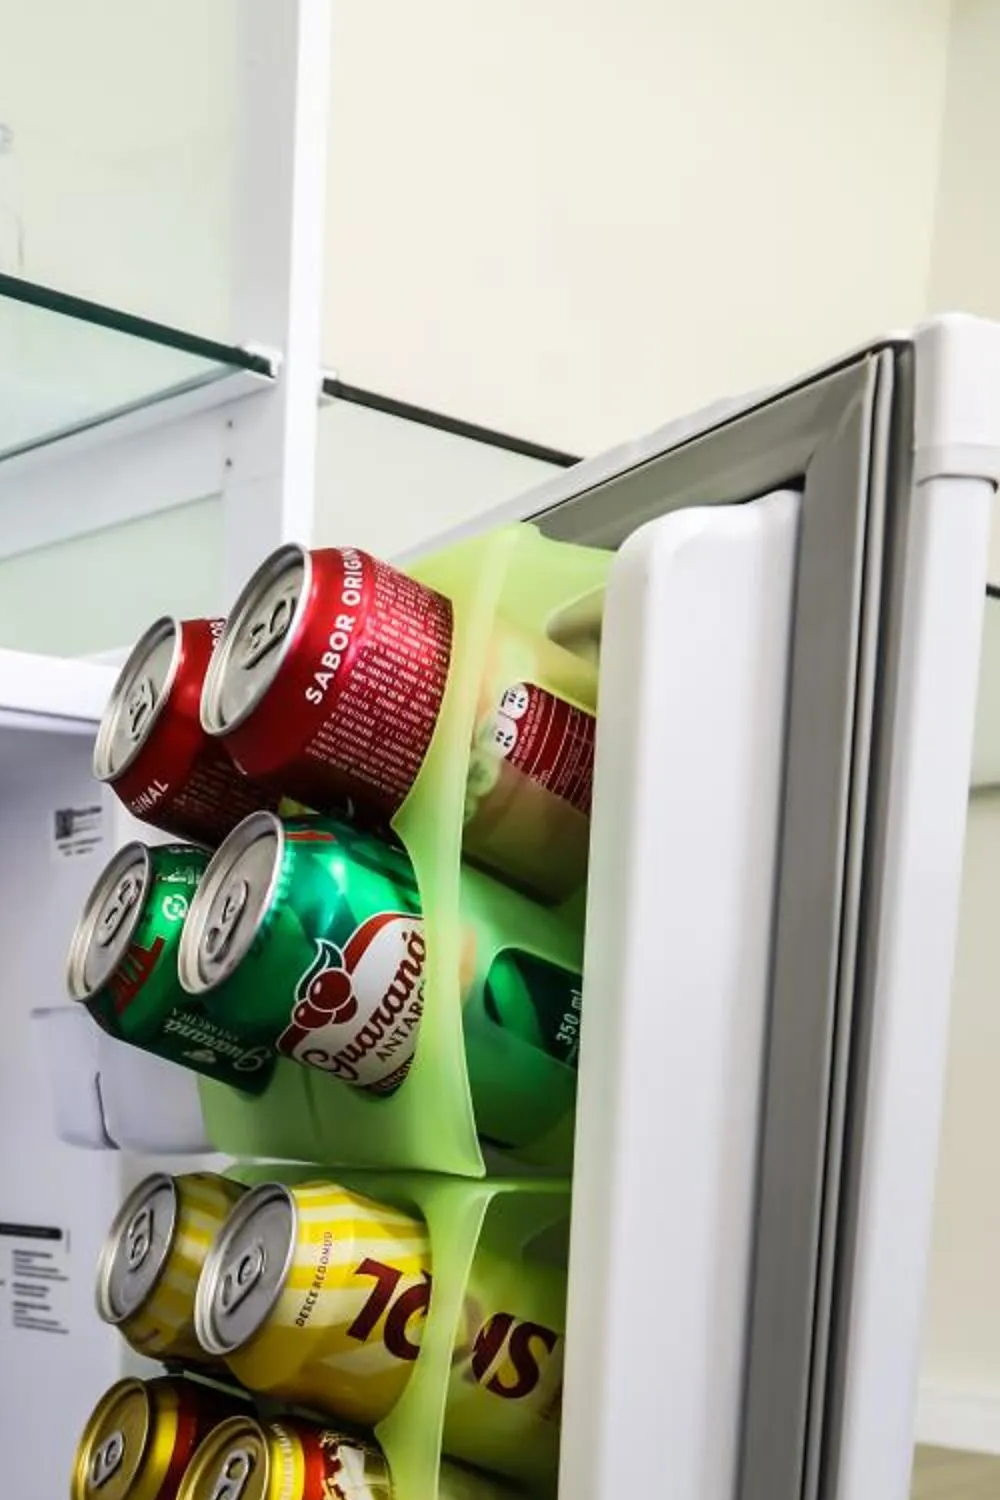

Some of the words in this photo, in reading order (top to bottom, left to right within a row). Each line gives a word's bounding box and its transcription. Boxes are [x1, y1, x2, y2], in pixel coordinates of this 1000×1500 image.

[304, 613, 357, 705] SABOR
[301, 929, 427, 1081] Guaraná
[555, 1012, 579, 1045] 350
